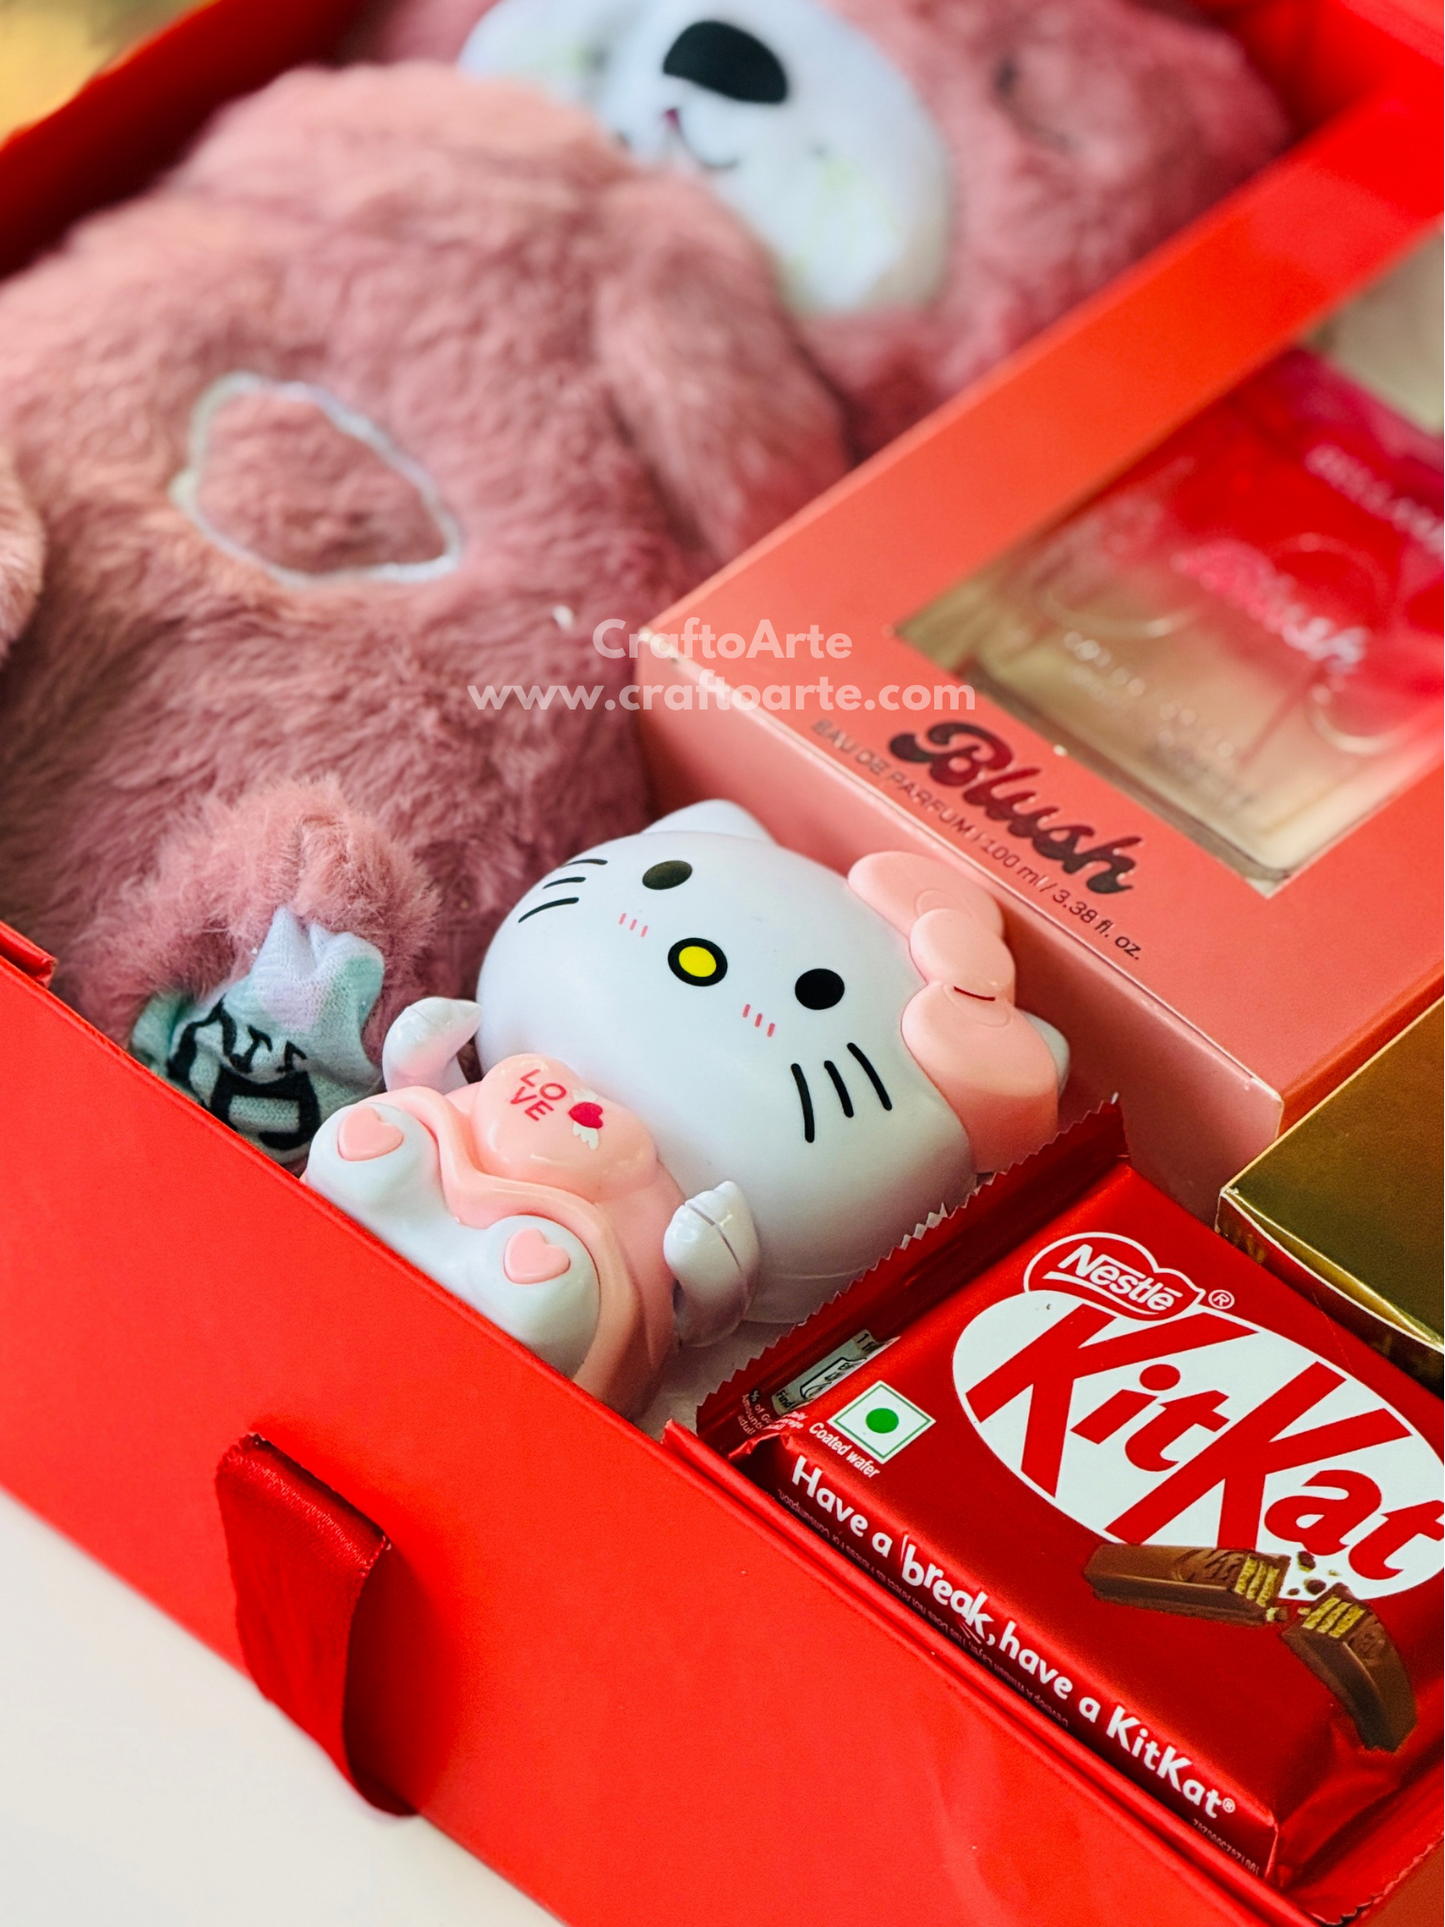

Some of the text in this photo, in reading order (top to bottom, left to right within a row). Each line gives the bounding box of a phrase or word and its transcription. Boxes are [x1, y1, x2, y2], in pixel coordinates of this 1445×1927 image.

[888, 721, 1142, 894] Blush
[889, 771, 977, 834] PARFUM
[979, 839, 1021, 868] 100
[1017, 865, 1047, 887] ml
[1052, 889, 1099, 924] 3.38
[1094, 919, 1114, 938] fl.
[1114, 935, 1142, 960] oz.
[809, 1422, 881, 1479] Coated wafer
[965, 1303, 1445, 1581] KitKat
[791, 1455, 869, 1537] Have
[871, 1531, 893, 1559] a
[901, 1543, 995, 1647] break,
[998, 1620, 1074, 1700] have
[1078, 1696, 1101, 1724] a
